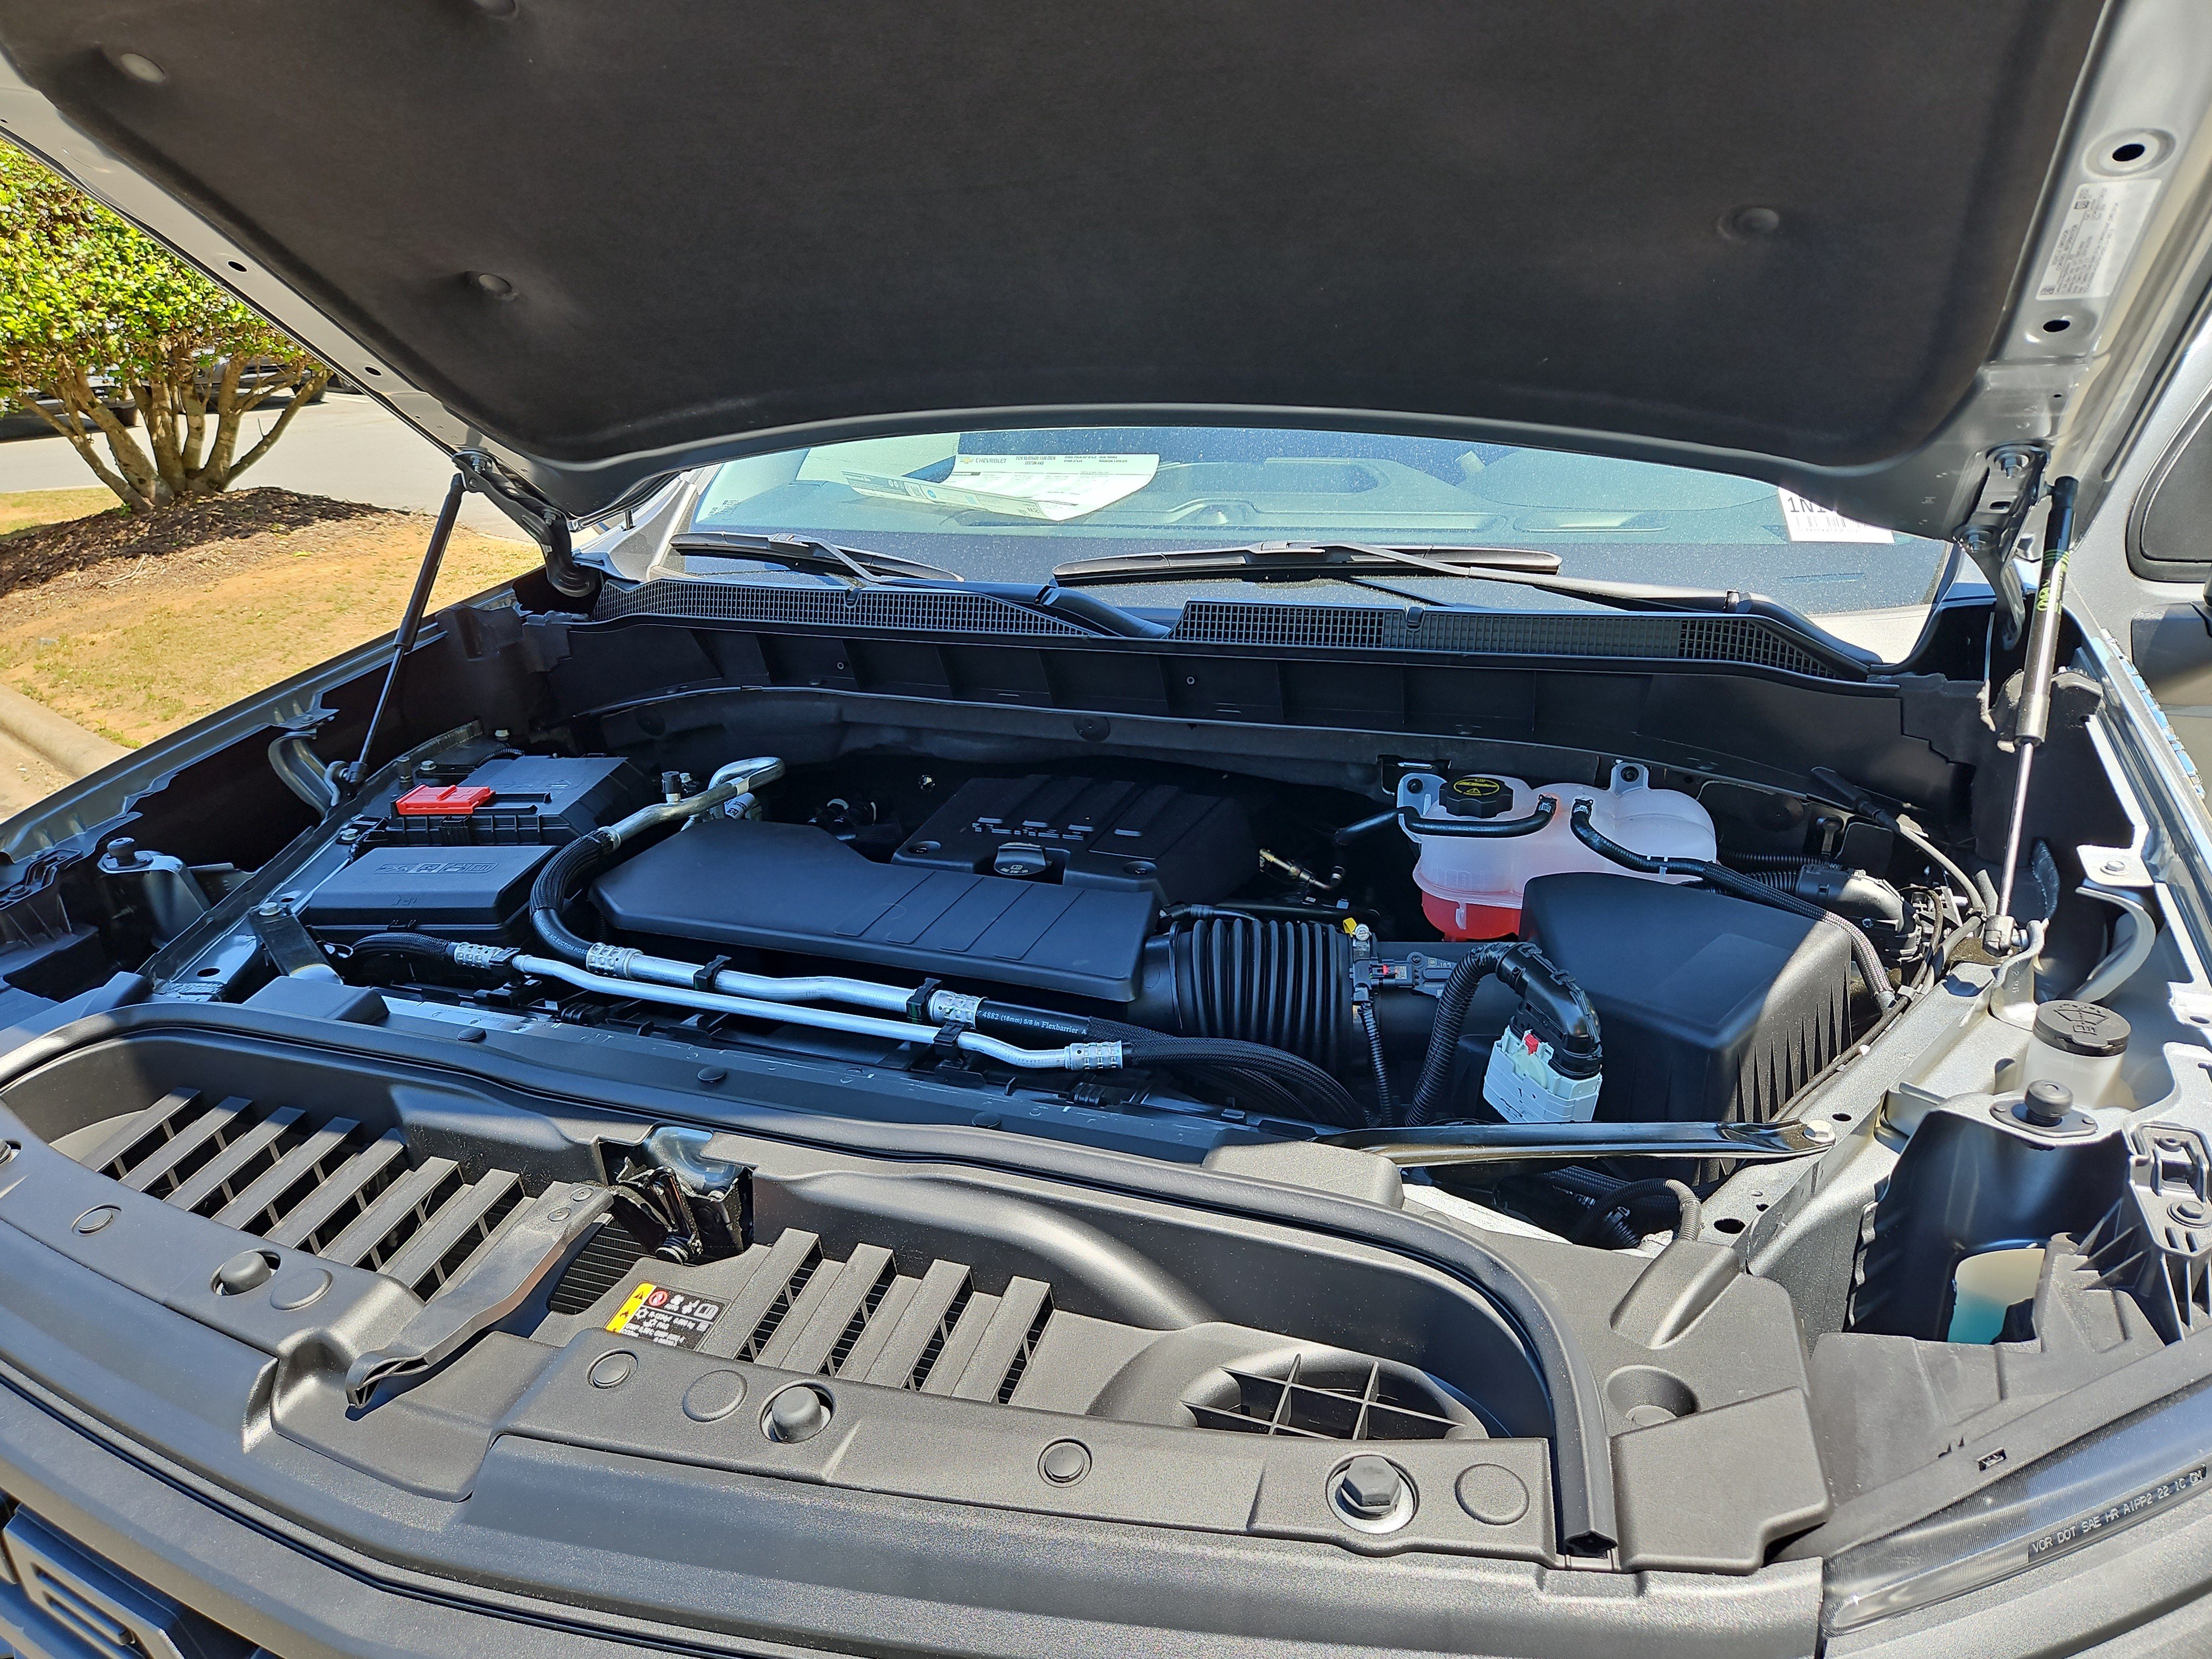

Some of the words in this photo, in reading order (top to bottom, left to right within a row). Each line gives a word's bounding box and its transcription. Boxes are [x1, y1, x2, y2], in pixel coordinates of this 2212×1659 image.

[556, 938, 575, 951] SUCTION
[982, 1011, 999, 1020] 4882
[1001, 1014, 1023, 1025] (16mm)
[1041, 1020, 1079, 1034] Flexbarrier
[664, 1303, 680, 1311] AUTO
[656, 1321, 670, 1330] PAG
[2033, 1537, 2054, 1553] VOR
[2057, 1526, 2076, 1544] DOT
[2081, 1516, 2102, 1534] SAE
[2105, 1508, 2120, 1523] HR
[2157, 1485, 2171, 1500] 22
